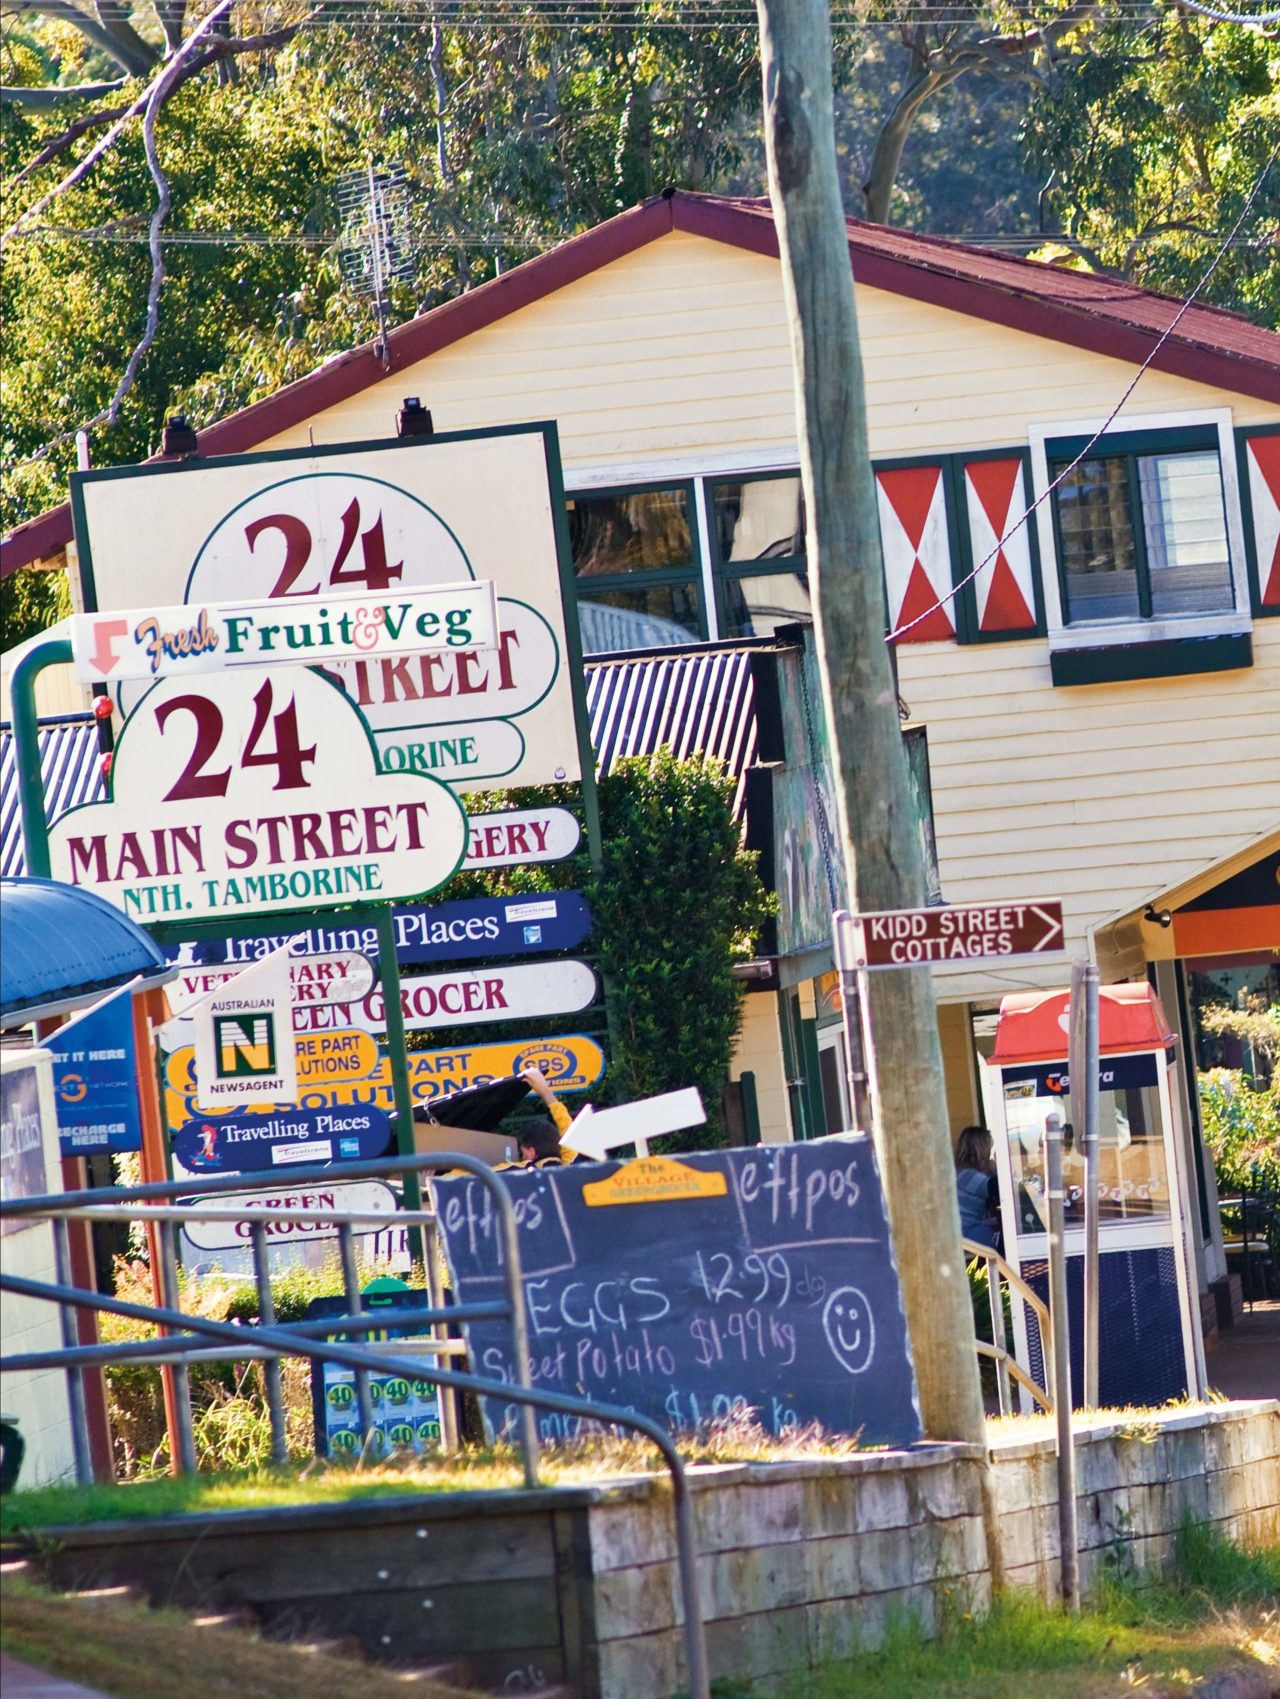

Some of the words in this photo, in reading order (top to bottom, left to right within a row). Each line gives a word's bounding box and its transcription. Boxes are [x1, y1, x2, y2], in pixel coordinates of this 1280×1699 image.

[244, 496, 404, 599] 24
[134, 609, 219, 674] Fresh
[154, 677, 318, 802] 24
[380, 736, 480, 772] ORINE
[67, 825, 205, 885] MAIN
[225, 802, 430, 870] STREET
[465, 820, 551, 859] GERY
[123, 885, 192, 915] NTH.
[202, 863, 383, 907] TAMBORINE
[394, 912, 500, 947] Places
[871, 915, 927, 940] KIDD
[940, 906, 1026, 934] STREET
[890, 933, 1013, 963] COTTAGES
[211, 998, 275, 1011] AUSTRALIAN
[89, 1049, 126, 1061] HERE
[321, 1035, 361, 1054] PART
[210, 1080, 284, 1094] NEWSAGENT
[72, 1134, 108, 1146] HERE
[221, 1118, 310, 1143] Travelling
[315, 1115, 370, 1134] Places
[637, 1164, 665, 1174] The
[741, 1148, 860, 1231] eftpos
[527, 1277, 670, 1334] EGGS
[696, 1250, 791, 1308] 12.99
[577, 1328, 676, 1381] Potato
[386, 1382, 410, 1399] 40
[390, 1428, 412, 1445] 40
